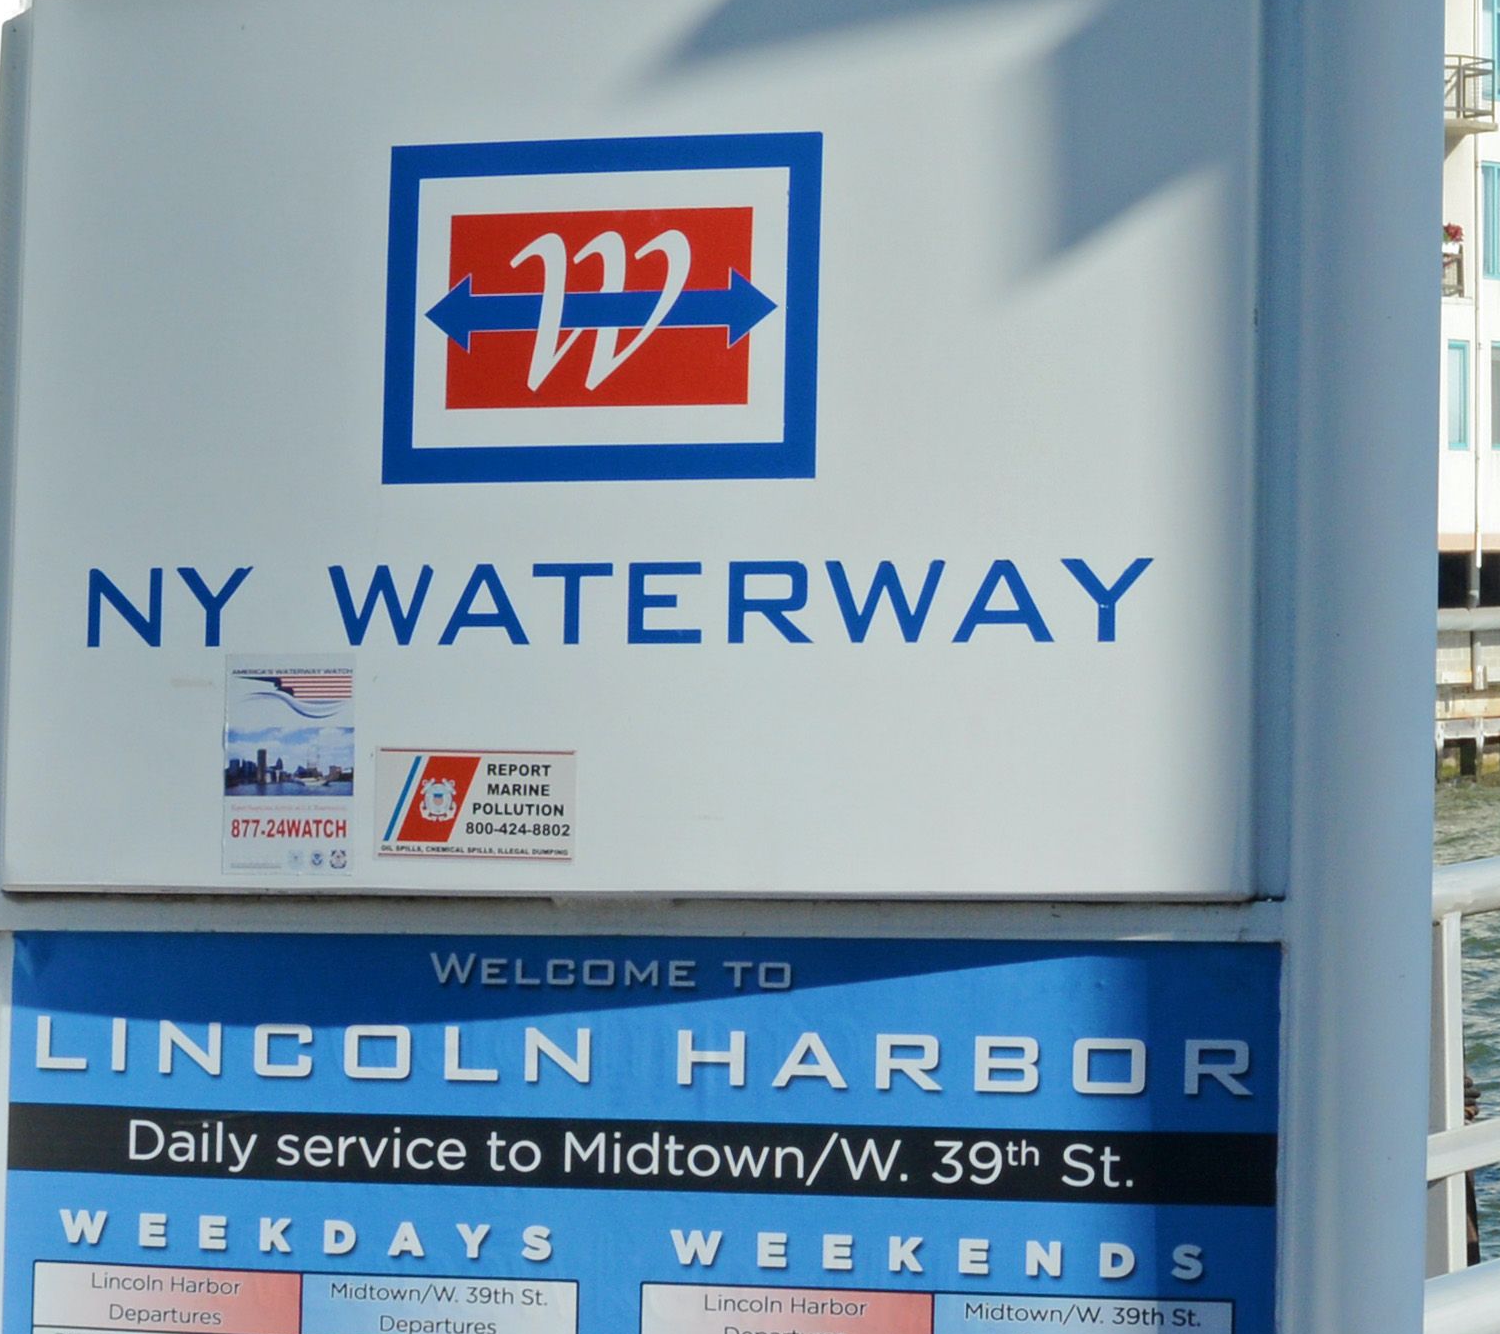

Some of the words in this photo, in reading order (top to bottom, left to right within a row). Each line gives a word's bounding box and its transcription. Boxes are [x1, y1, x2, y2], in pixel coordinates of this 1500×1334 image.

[86, 566, 253, 649] NY
[328, 556, 1154, 646] WATERWAY
[323, 668, 353, 676] WATCH
[487, 763, 552, 778] REPORT
[487, 783, 551, 797] MARINE
[472, 803, 565, 818] POLLUTION
[231, 819, 347, 838] 877-24WATCH
[465, 822, 571, 837] 800-424-8802
[381, 844, 394, 852] OIL
[426, 846, 465, 854] CHEMICAL
[34, 1016, 594, 1084] LINCOLN
[677, 1030, 1252, 1097] HARBOR
[127, 1119, 257, 1175] Daily
[276, 1126, 467, 1173] service
[486, 1135, 541, 1175] to
[563, 1129, 912, 1189] Midtown/W.
[931, 1139, 1041, 1187] 39th
[1060, 1142, 1134, 1190] St.
[60, 1208, 554, 1263] WEEKDAYS
[672, 1229, 1206, 1283] WEEKENDS
[91, 1272, 165, 1293] Lincoln
[170, 1277, 242, 1297] Harbor
[331, 1282, 458, 1305] Midtown/W.
[466, 1287, 517, 1307] 39th
[521, 1288, 549, 1308] St.
[108, 1303, 222, 1327] Departures
[703, 1293, 784, 1314] Lincoln
[790, 1296, 868, 1317] Harbor
[964, 1301, 1104, 1326] Midtown/W.
[1112, 1306, 1166, 1327] 39th
[1171, 1307, 1202, 1328] St.
